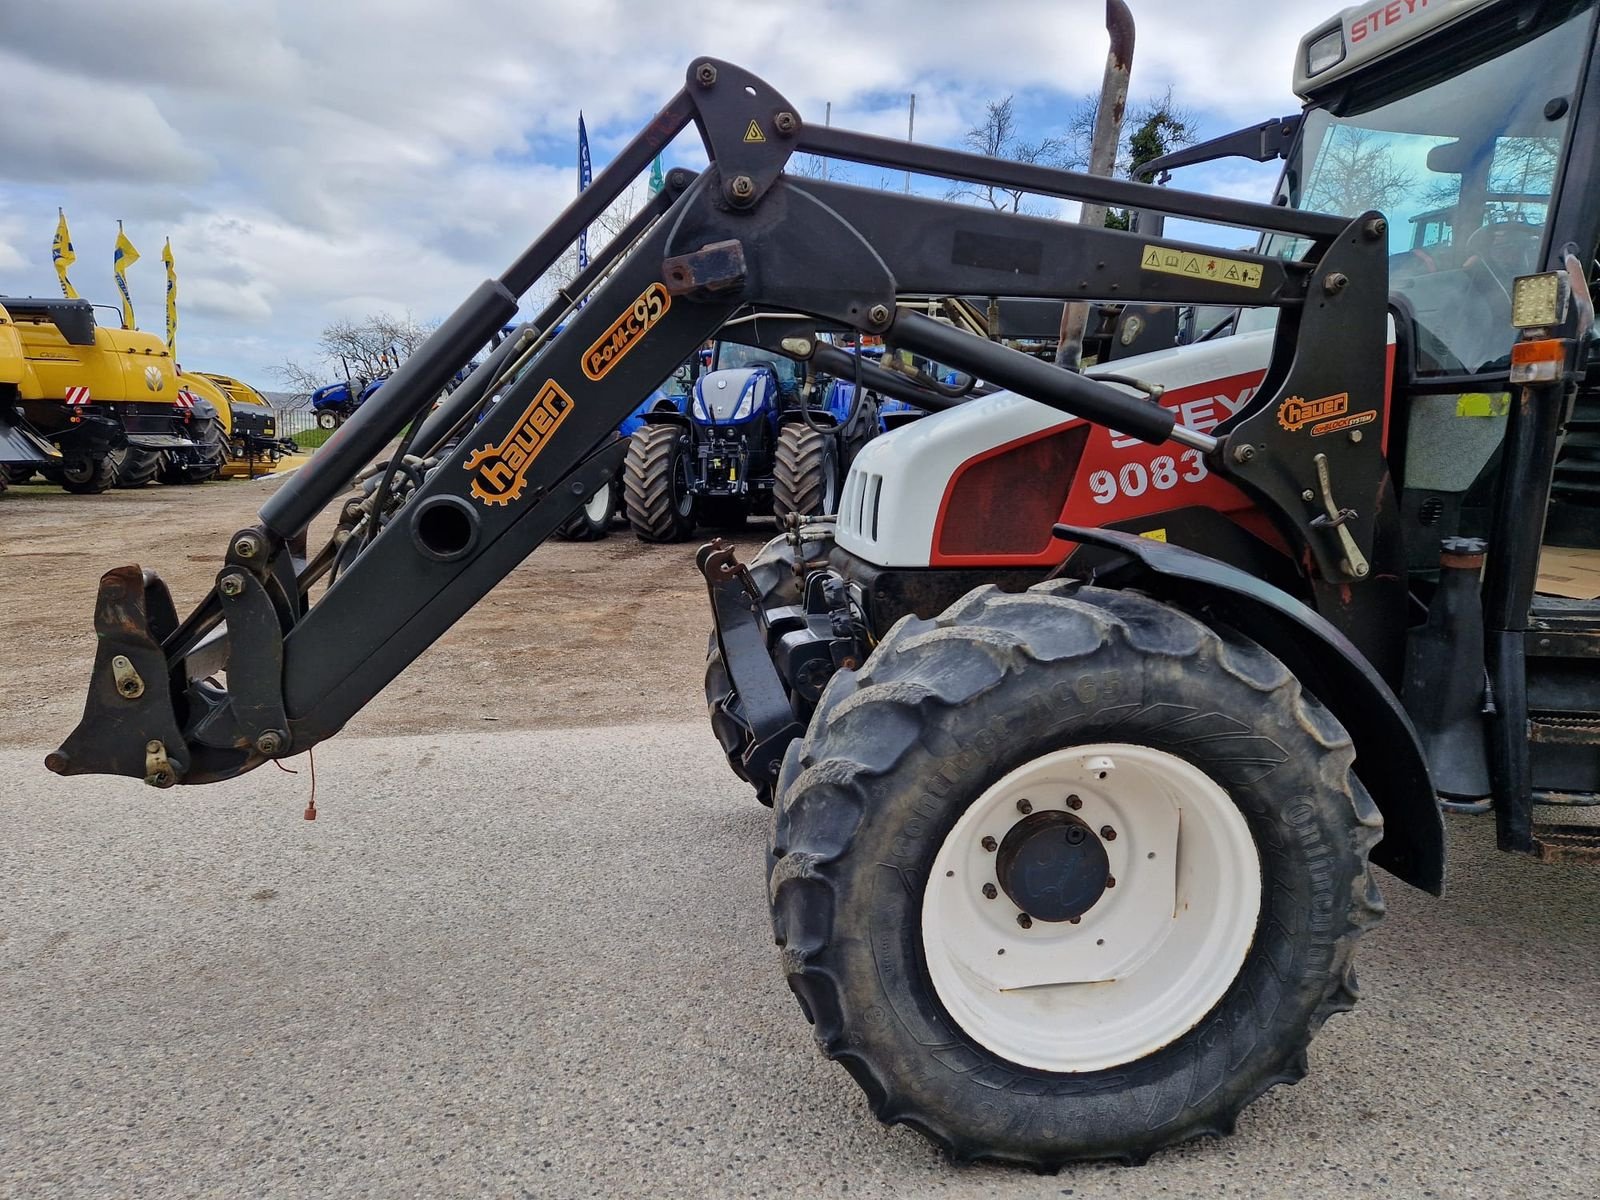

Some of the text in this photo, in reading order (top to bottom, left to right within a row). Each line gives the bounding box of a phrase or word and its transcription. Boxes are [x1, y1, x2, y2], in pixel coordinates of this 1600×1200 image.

[1351, 0, 1428, 43] STEY
[1288, 397, 1344, 423] hauer
[480, 389, 559, 492] hauer
[1089, 448, 1209, 504] 9083
